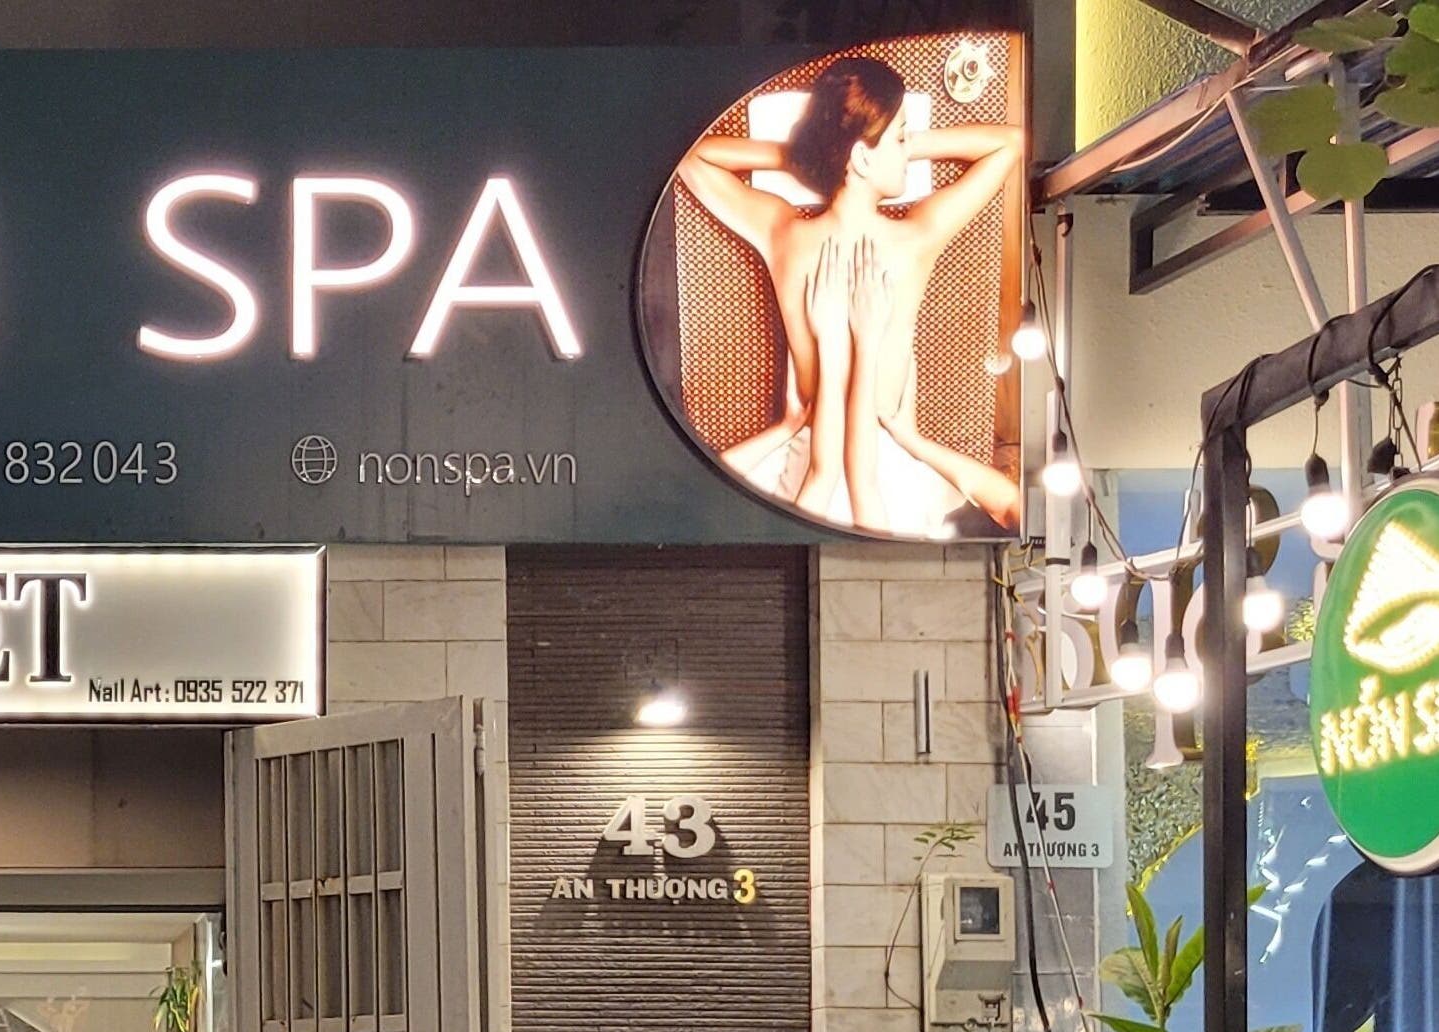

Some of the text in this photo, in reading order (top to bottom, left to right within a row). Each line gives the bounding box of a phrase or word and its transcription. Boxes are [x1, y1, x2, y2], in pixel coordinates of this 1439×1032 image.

[137, 174, 582, 360] SPA
[359, 451, 577, 496] nonspa.vn
[89, 678, 125, 703] Nail
[174, 679, 223, 704] 0935
[231, 680, 267, 704] 522
[275, 680, 304, 704] 371
[1320, 674, 1410, 776] NÓN
[603, 796, 716, 858] 43
[1026, 792, 1076, 831] 45
[1091, 843, 1100, 857] 3
[551, 878, 594, 899] AN
[733, 868, 756, 904] 3
